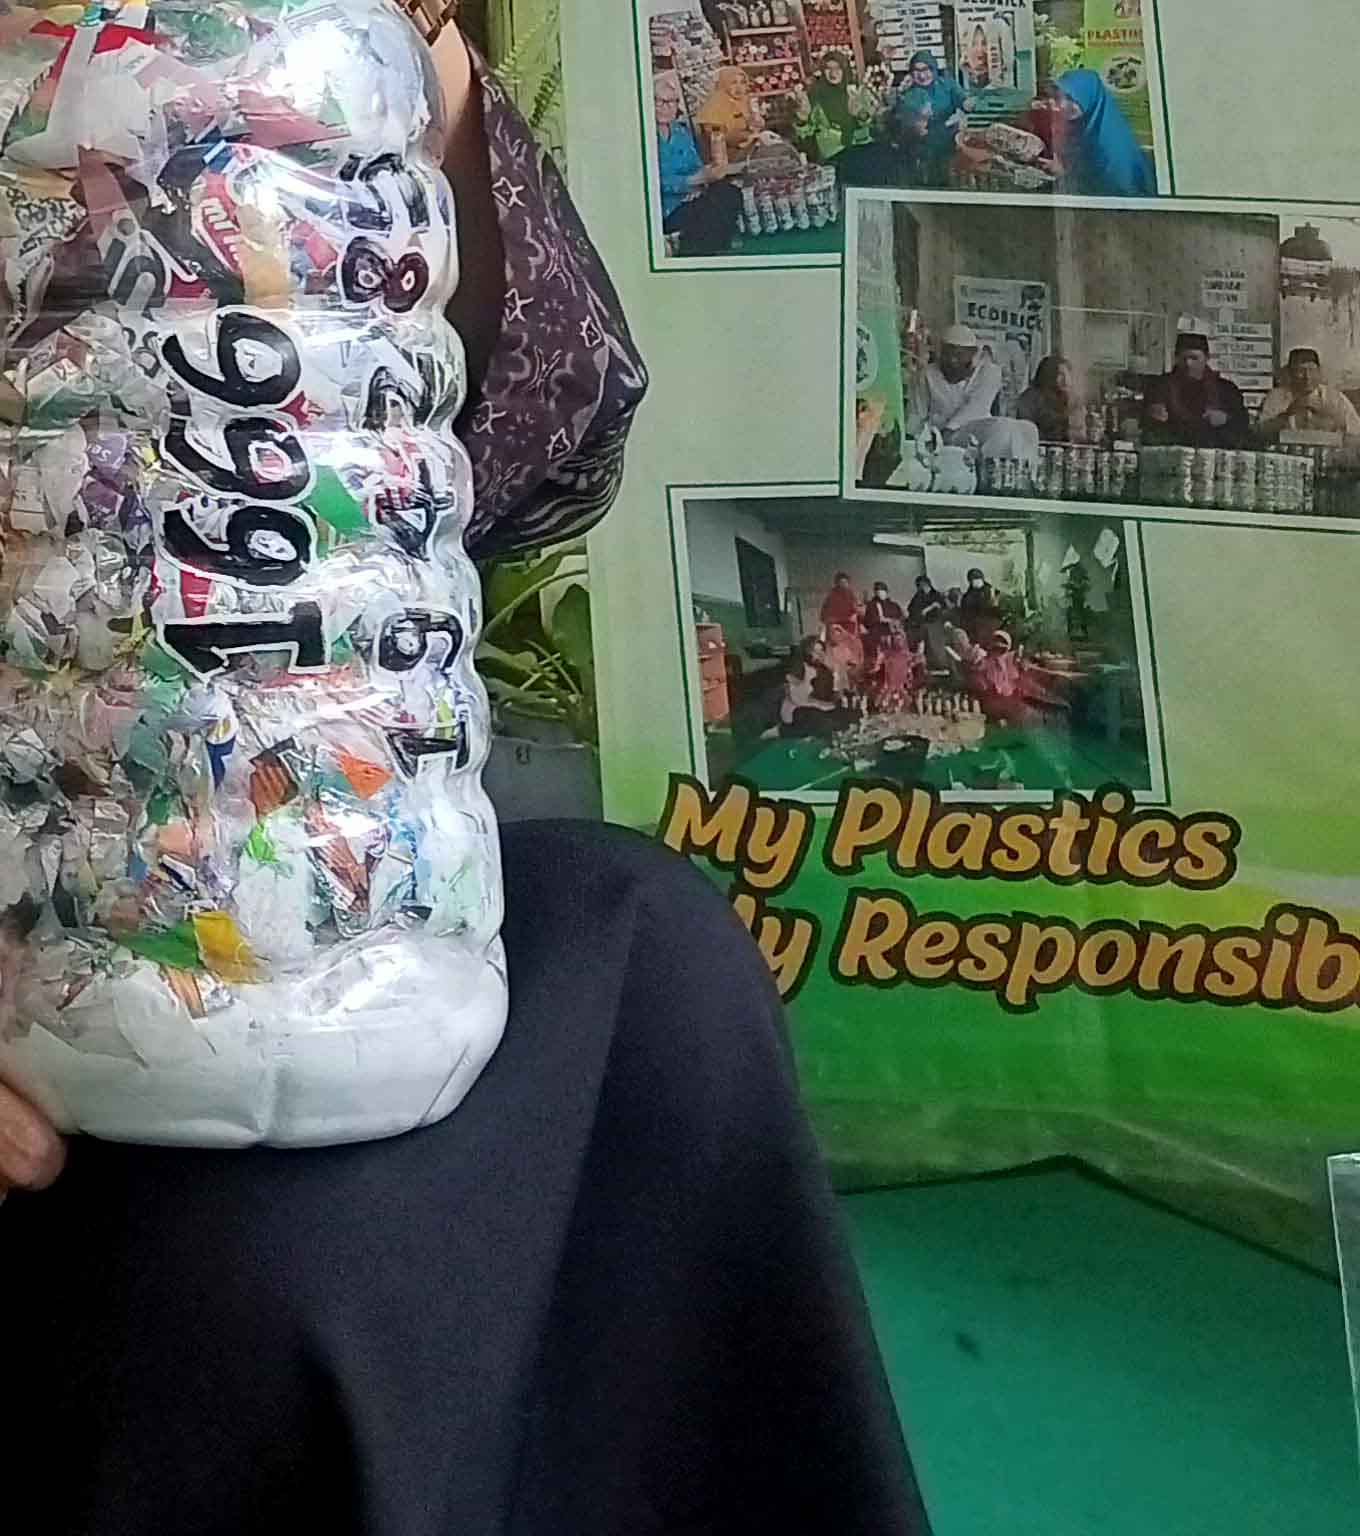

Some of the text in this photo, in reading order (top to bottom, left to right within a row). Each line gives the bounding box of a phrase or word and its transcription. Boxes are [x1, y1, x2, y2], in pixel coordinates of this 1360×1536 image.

[161, 310, 326, 673] 1666
[662, 776, 1234, 888] My Plastics
[837, 892, 1360, 1009] Responsib
